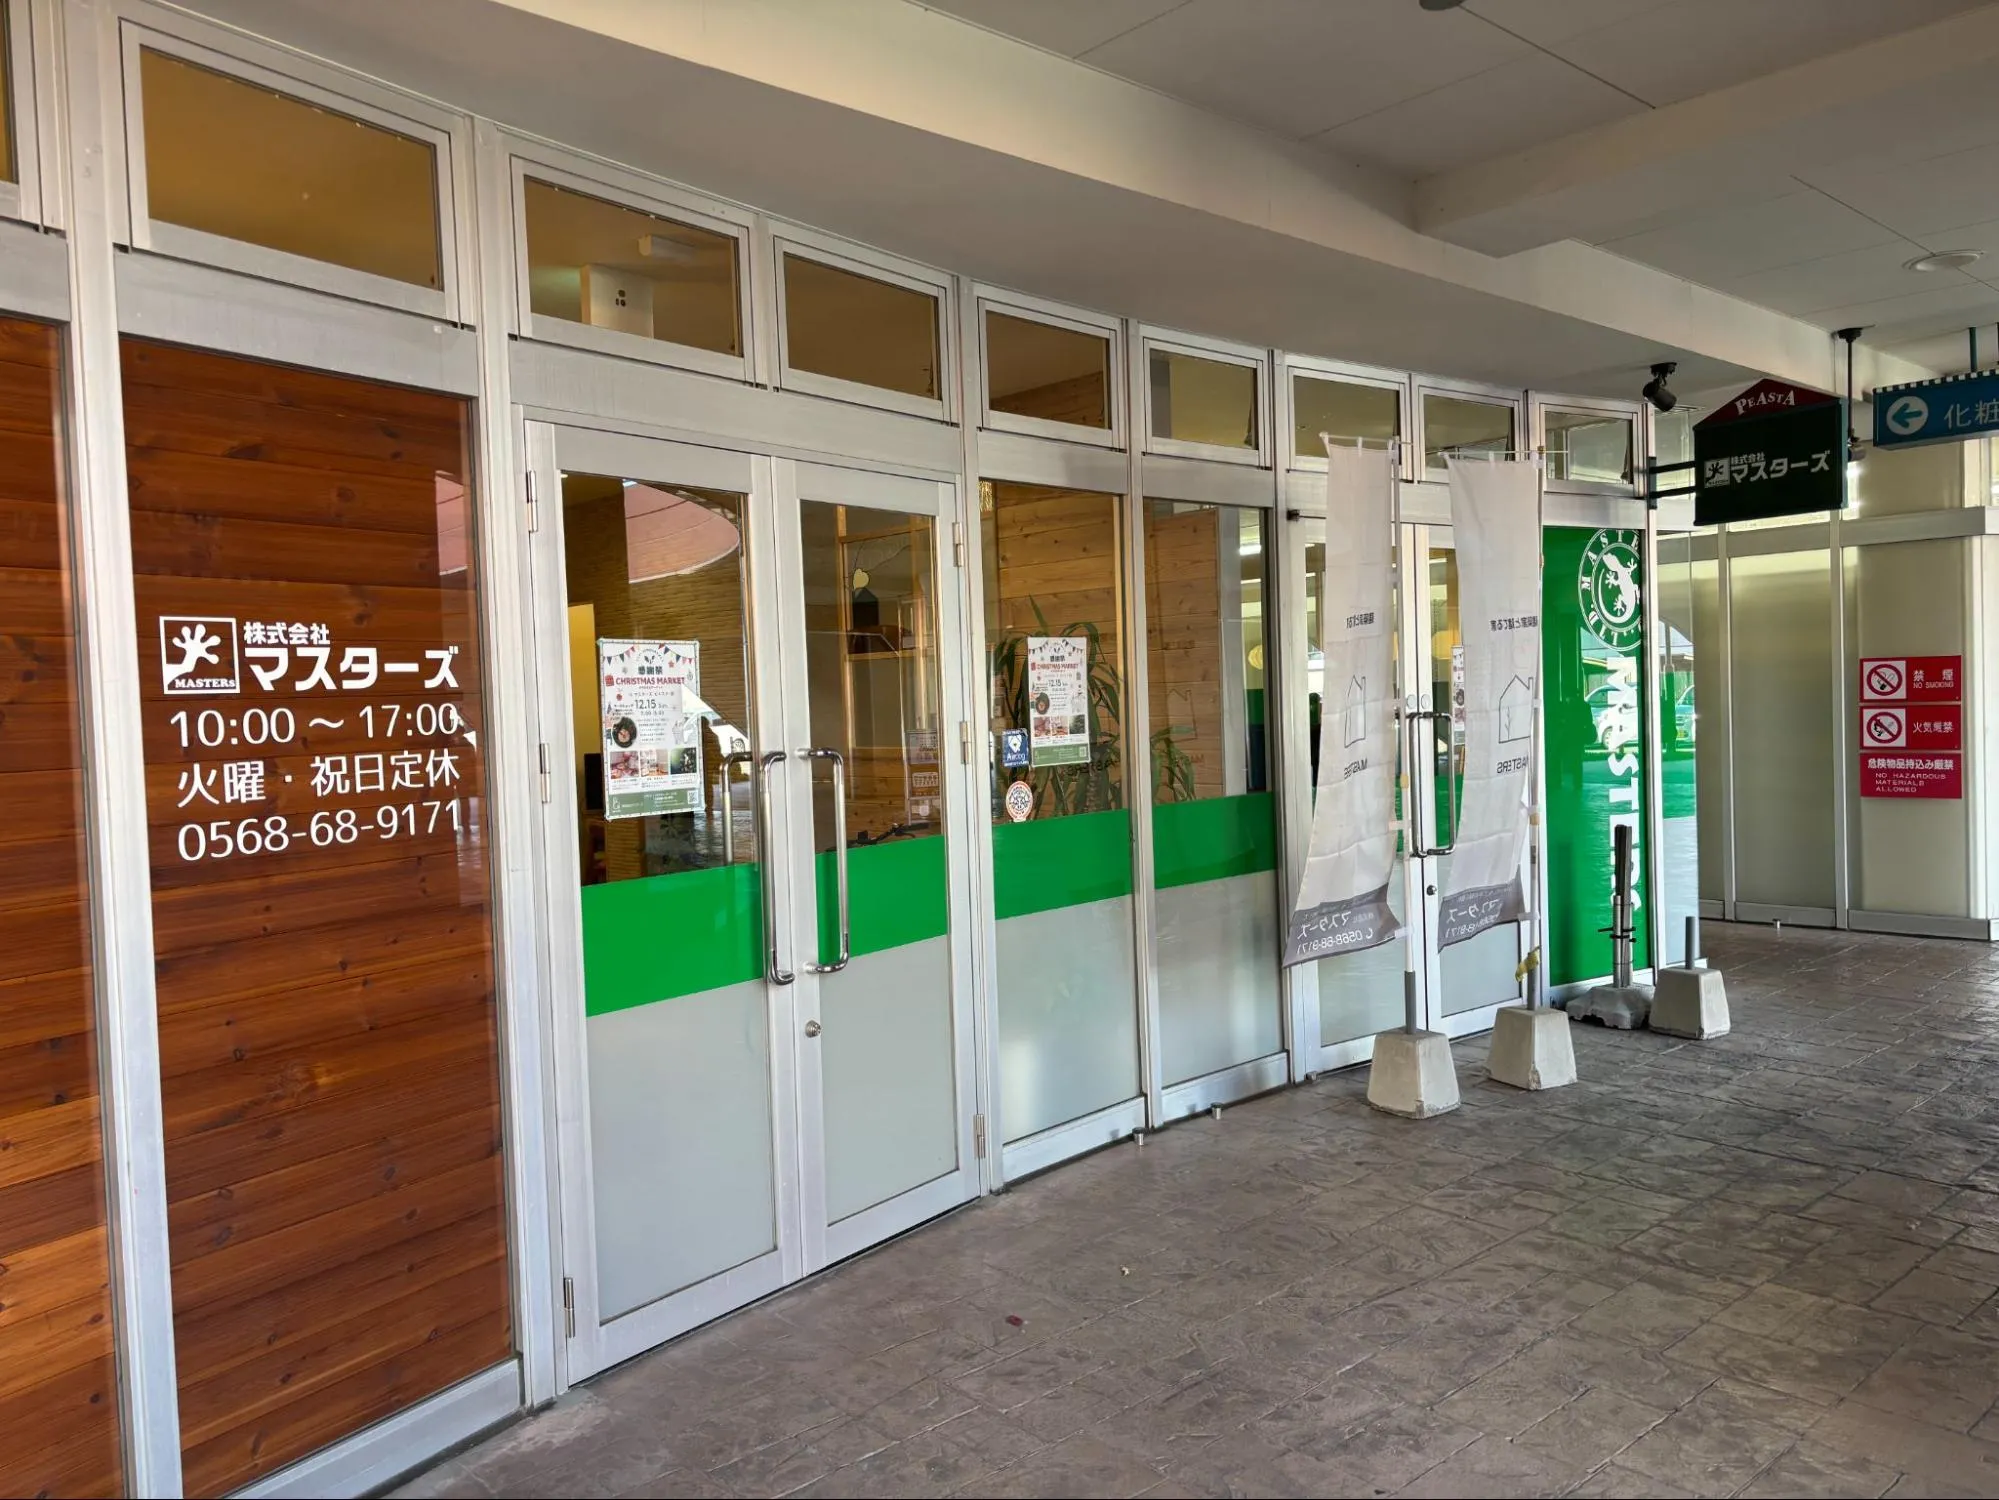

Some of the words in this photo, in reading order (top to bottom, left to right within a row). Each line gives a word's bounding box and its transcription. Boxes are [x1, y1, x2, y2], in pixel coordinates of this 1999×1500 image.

[1731, 452, 1765, 465] 株式会社
[1731, 450, 1831, 483] マスターズ
[244, 622, 330, 644] 株式会社
[244, 646, 458, 691] マスターズ
[616, 677, 655, 685] CHRISTMAS
[657, 676, 685, 684] MARKET
[635, 699, 657, 709] 12.15
[170, 707, 295, 748] 10:00
[359, 703, 457, 738] 17:00
[178, 801, 458, 861] 0568-68-9171
